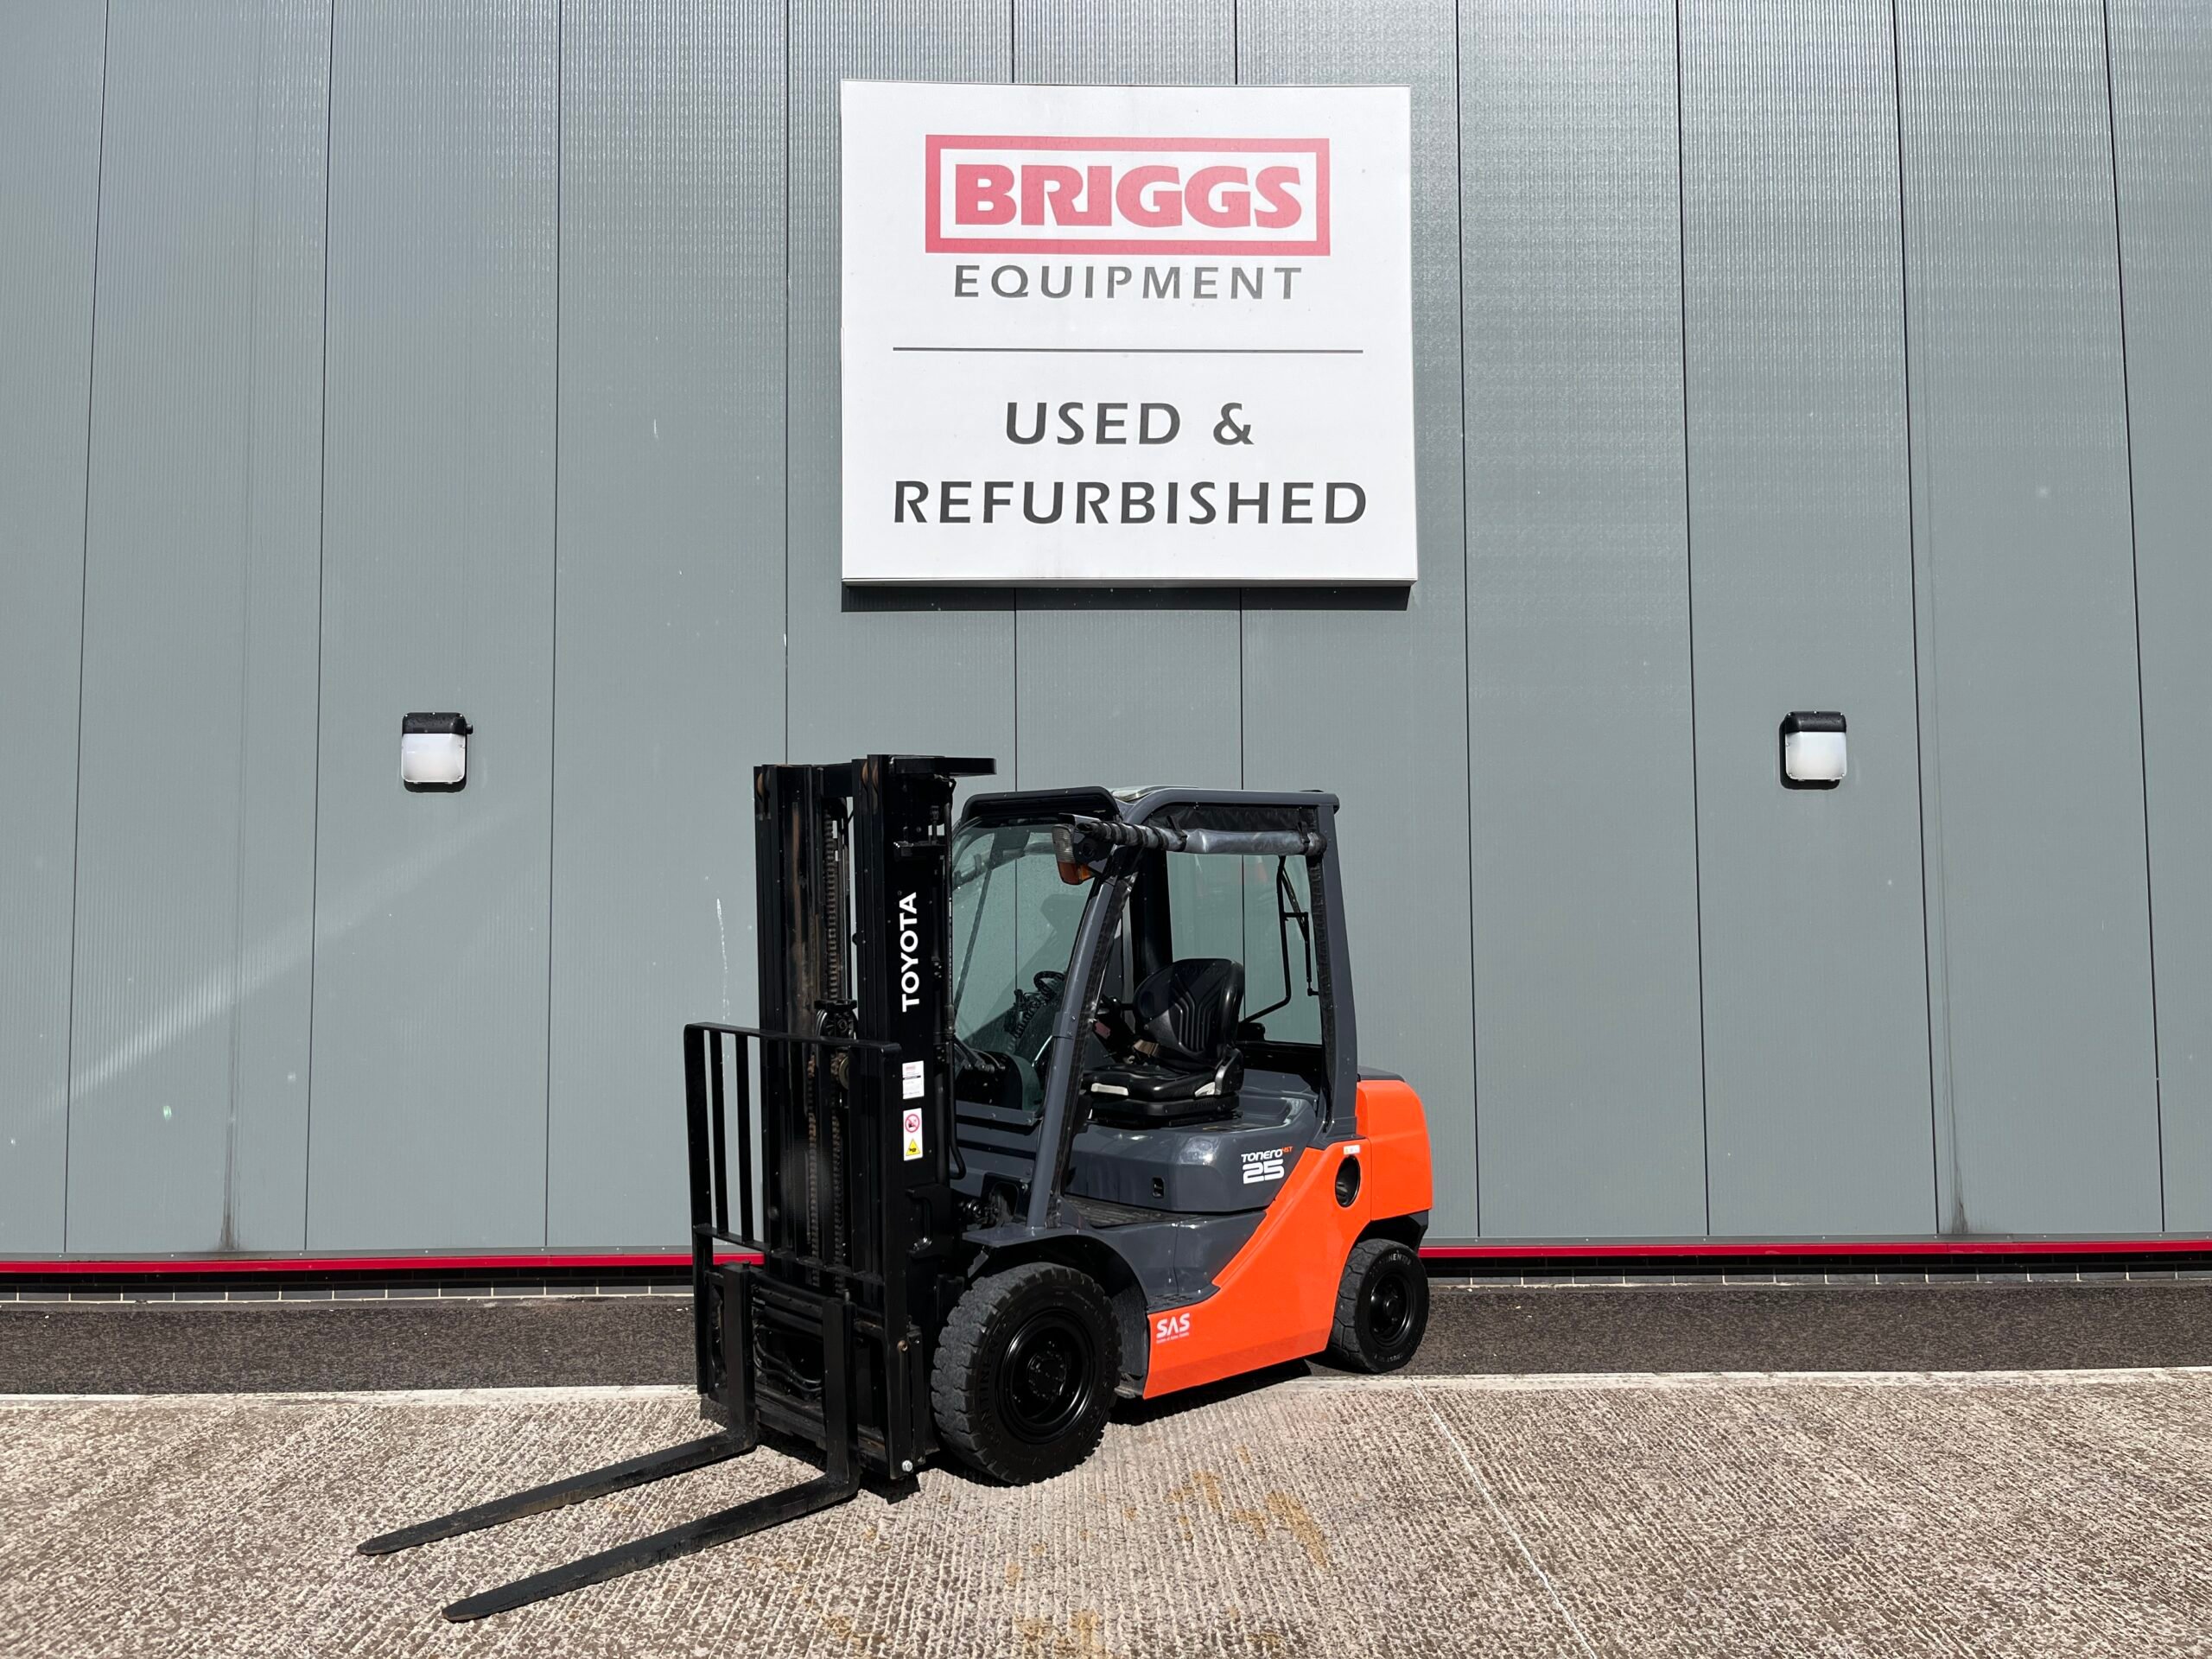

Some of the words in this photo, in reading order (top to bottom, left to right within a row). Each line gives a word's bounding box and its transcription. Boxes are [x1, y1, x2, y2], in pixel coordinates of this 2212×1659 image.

[955, 163, 1303, 229] BRIGGS
[953, 264, 1303, 301] EQUIPMENT
[1006, 402, 1182, 446] USED
[1212, 402, 1255, 446] &
[893, 480, 1368, 525] REFURBISHED
[899, 892, 920, 1013] TOYOTA
[1243, 1159, 1285, 1185] 25
[1156, 1313, 1191, 1338] SAS
